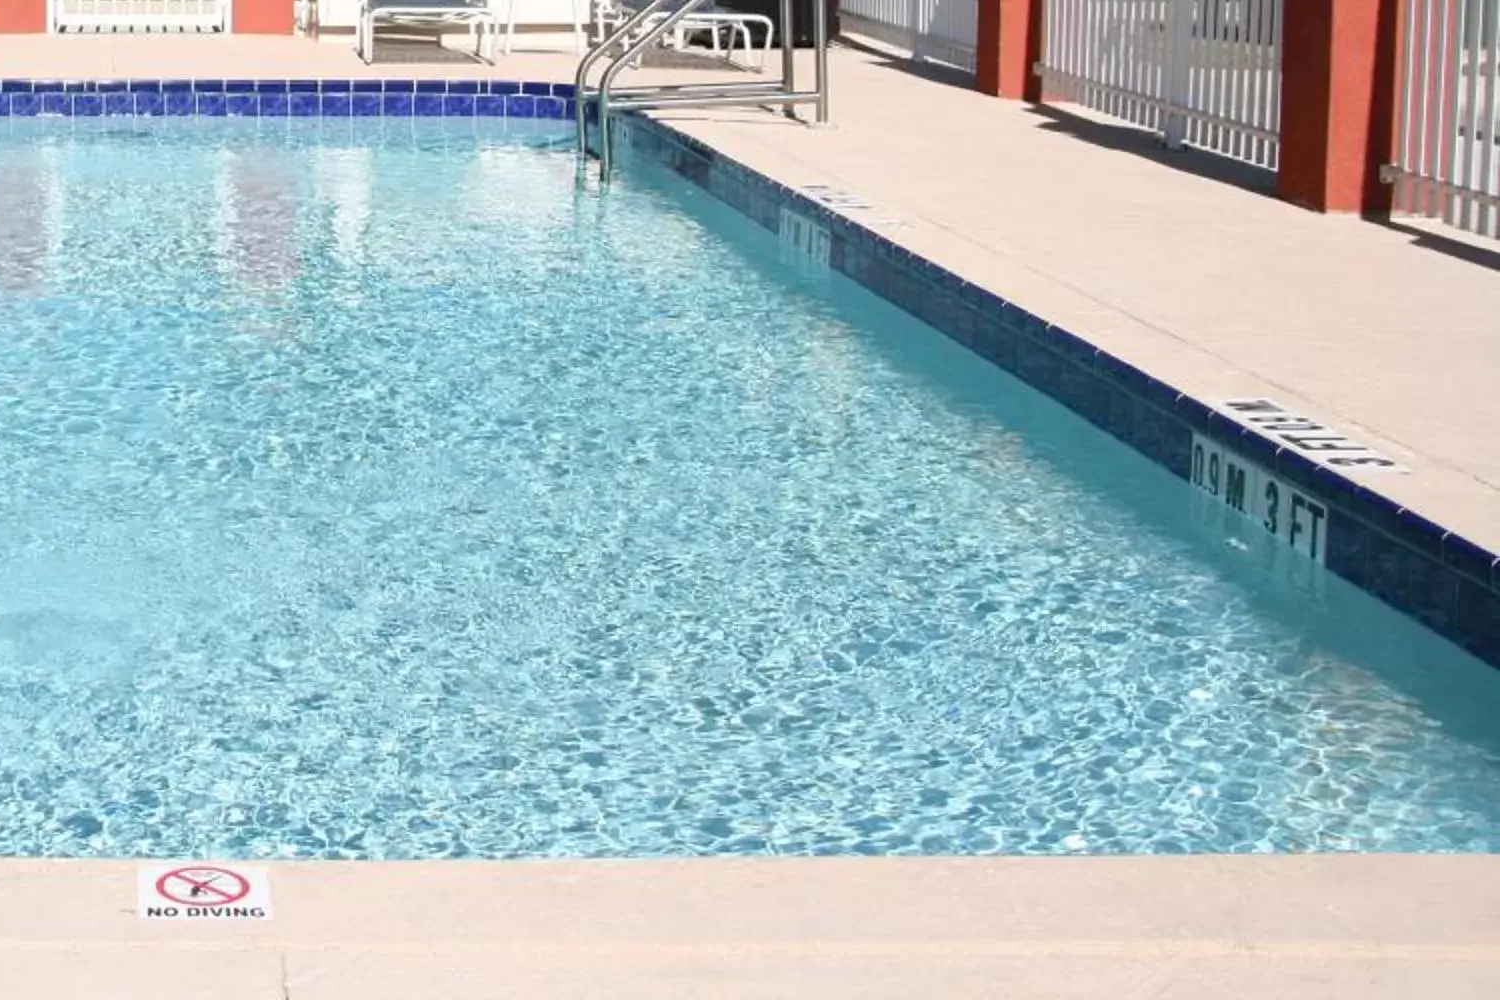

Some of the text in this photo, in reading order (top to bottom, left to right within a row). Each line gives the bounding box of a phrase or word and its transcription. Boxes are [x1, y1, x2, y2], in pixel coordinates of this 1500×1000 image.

[1277, 433, 1368, 450] FT
[1264, 480, 1279, 535] 3
[1289, 492, 1325, 559] FT
[147, 906, 266, 918] NO DIVING
